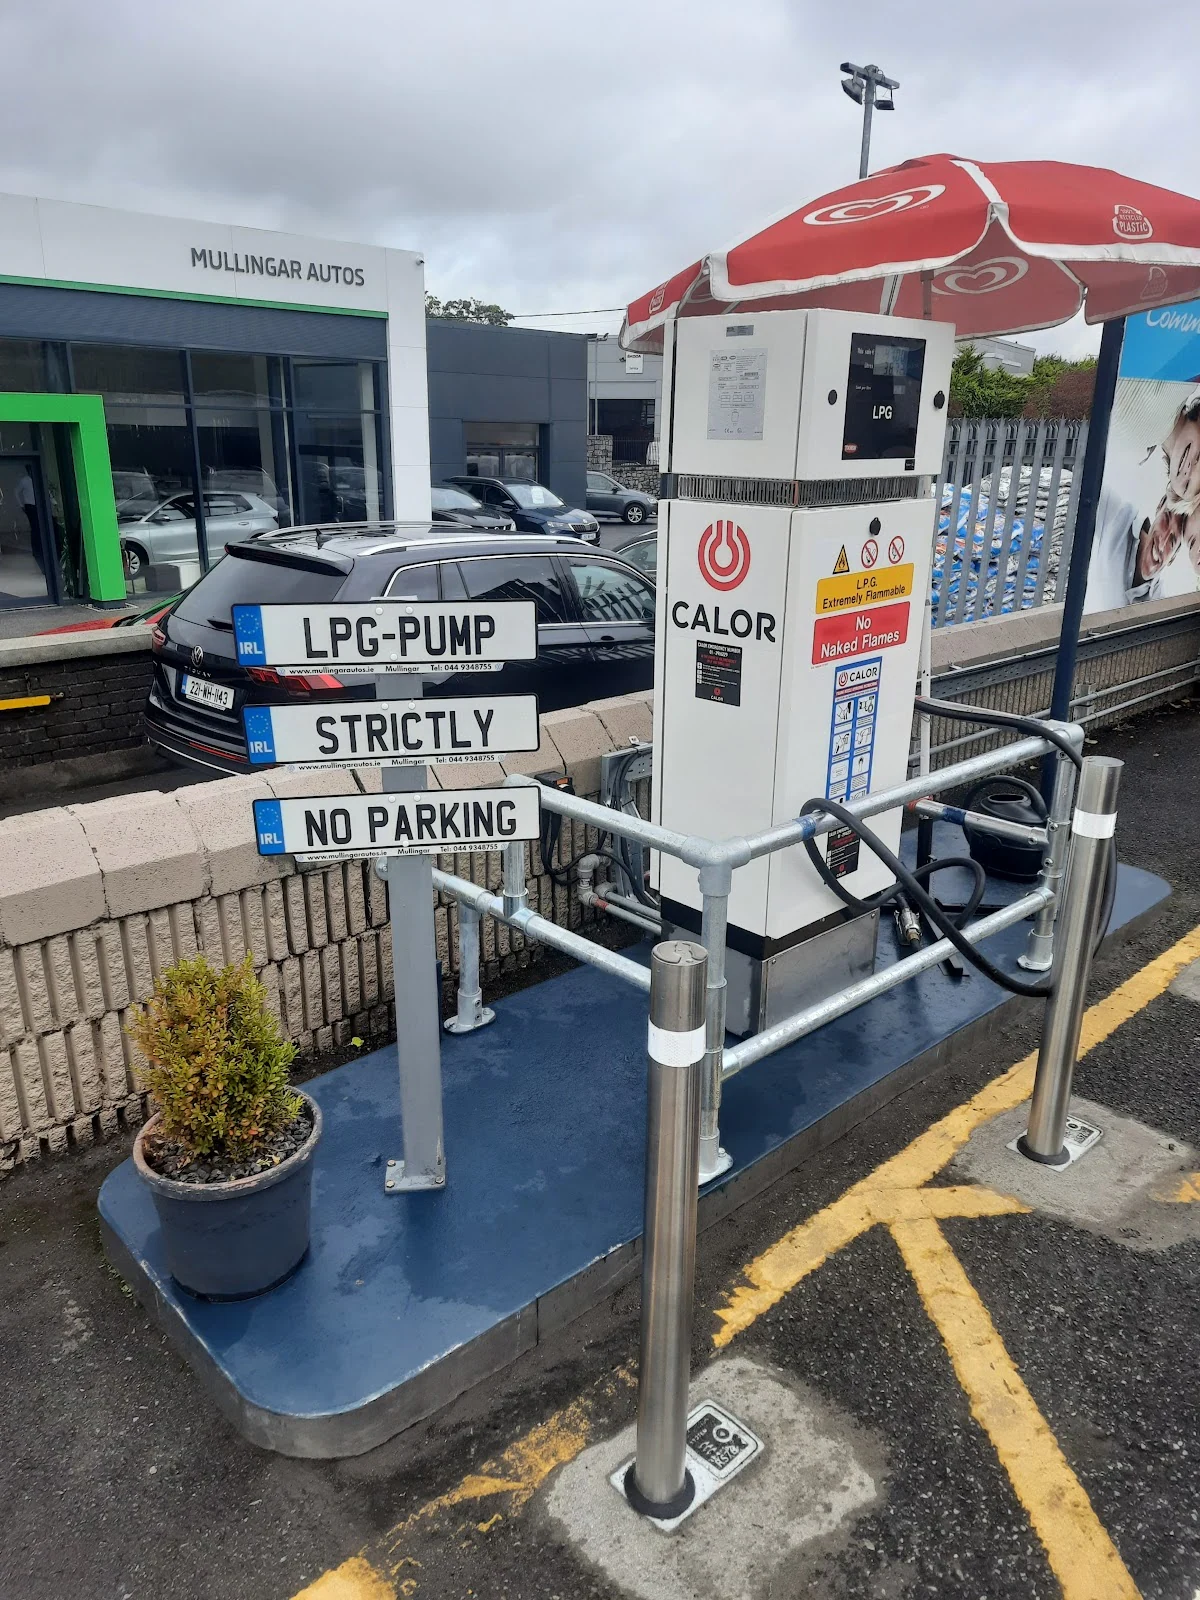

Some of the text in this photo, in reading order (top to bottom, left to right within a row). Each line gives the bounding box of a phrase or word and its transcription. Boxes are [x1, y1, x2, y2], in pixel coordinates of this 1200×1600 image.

[191, 248, 365, 286] MULLINGAR AUTOS
[872, 405, 893, 420] LPG
[856, 576, 878, 590] L.P.G.
[822, 584, 906, 610] Extremely Flammable
[672, 601, 776, 643] CALOR
[855, 614, 872, 631] No
[303, 615, 496, 659] LPG-PUMP
[820, 630, 900, 659] Naked Flames
[239, 641, 264, 655] IRL
[289, 666, 375, 675] www.mullingarautos.ie
[385, 665, 420, 674] Mullingar
[460, 663, 492, 671] 9348755
[849, 667, 878, 682] CALOR
[315, 709, 494, 755] STRICTLY
[249, 741, 273, 753] IRL
[298, 761, 381, 770] www.mullingarautos.ie
[391, 759, 425, 767] Mullingar
[304, 800, 517, 847] NO PARKING
[260, 833, 283, 845] IRL
[306, 850, 388, 861] www.mullingarautos.ie
[397, 848, 430, 856] Mullingar
[468, 843, 498, 851] 9348755
